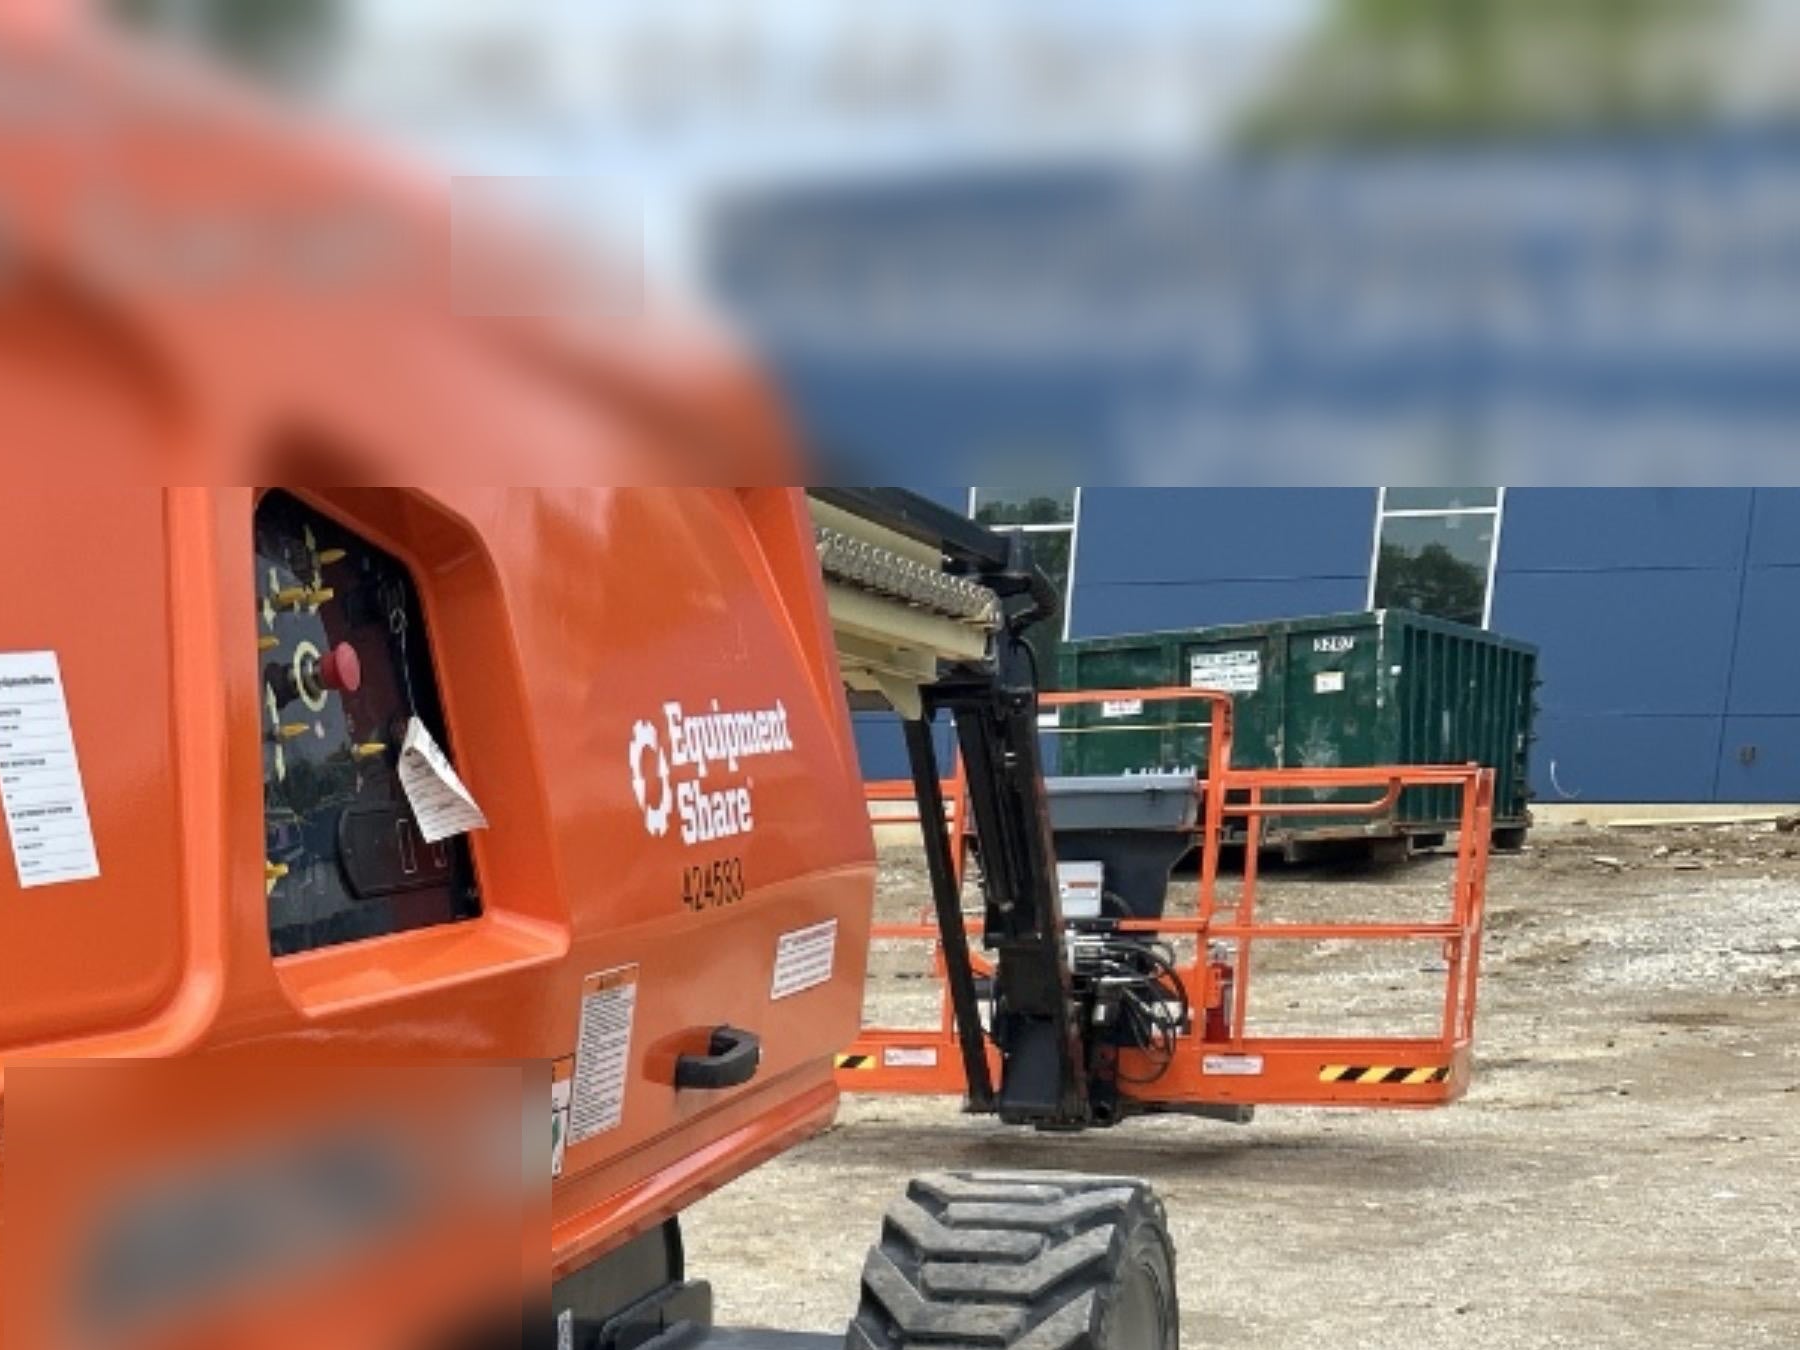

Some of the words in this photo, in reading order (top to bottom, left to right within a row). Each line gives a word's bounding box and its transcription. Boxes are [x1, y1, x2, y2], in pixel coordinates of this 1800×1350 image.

[663, 698, 793, 777] Equipment
[677, 779, 753, 845] Share
[682, 858, 745, 911] 424583
